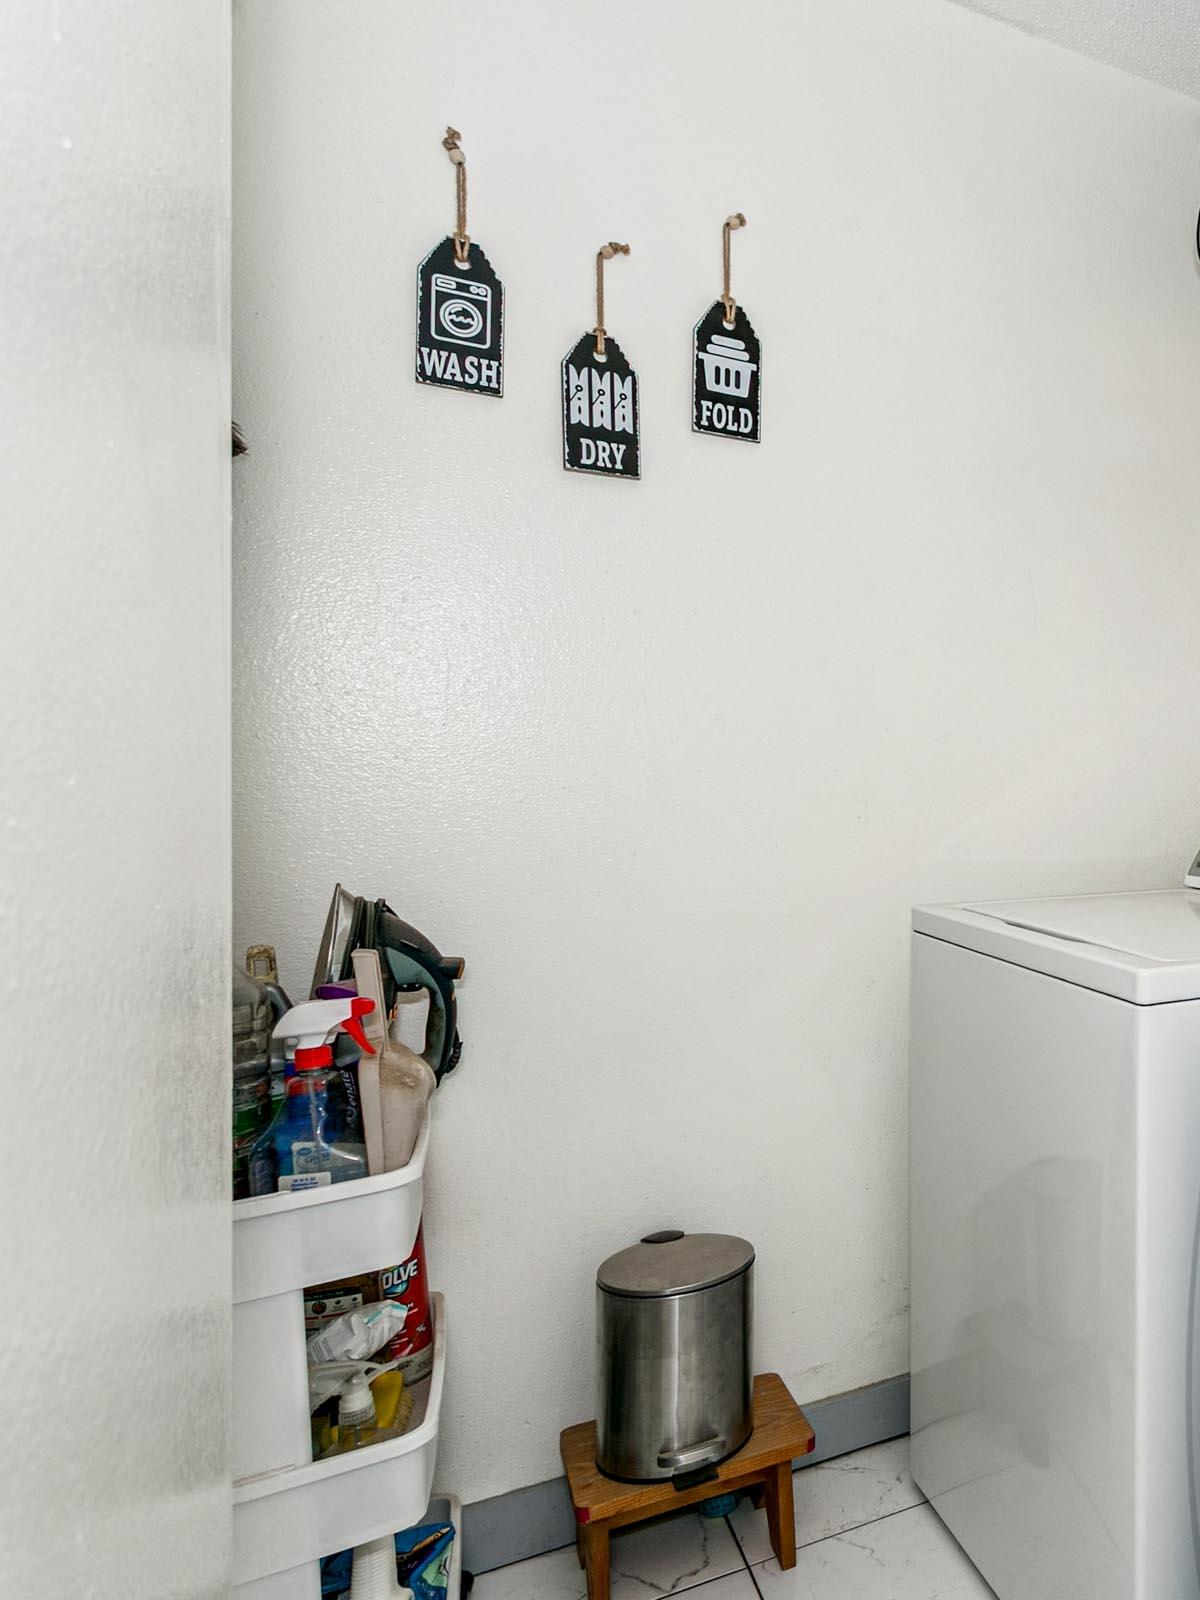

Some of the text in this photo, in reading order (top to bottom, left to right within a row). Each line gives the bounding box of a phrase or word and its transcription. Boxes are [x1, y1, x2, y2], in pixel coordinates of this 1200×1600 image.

[421, 347, 499, 388] WASH
[700, 400, 753, 434] FOLD
[579, 437, 626, 470] DRY
[382, 1259, 418, 1289] OLVE
